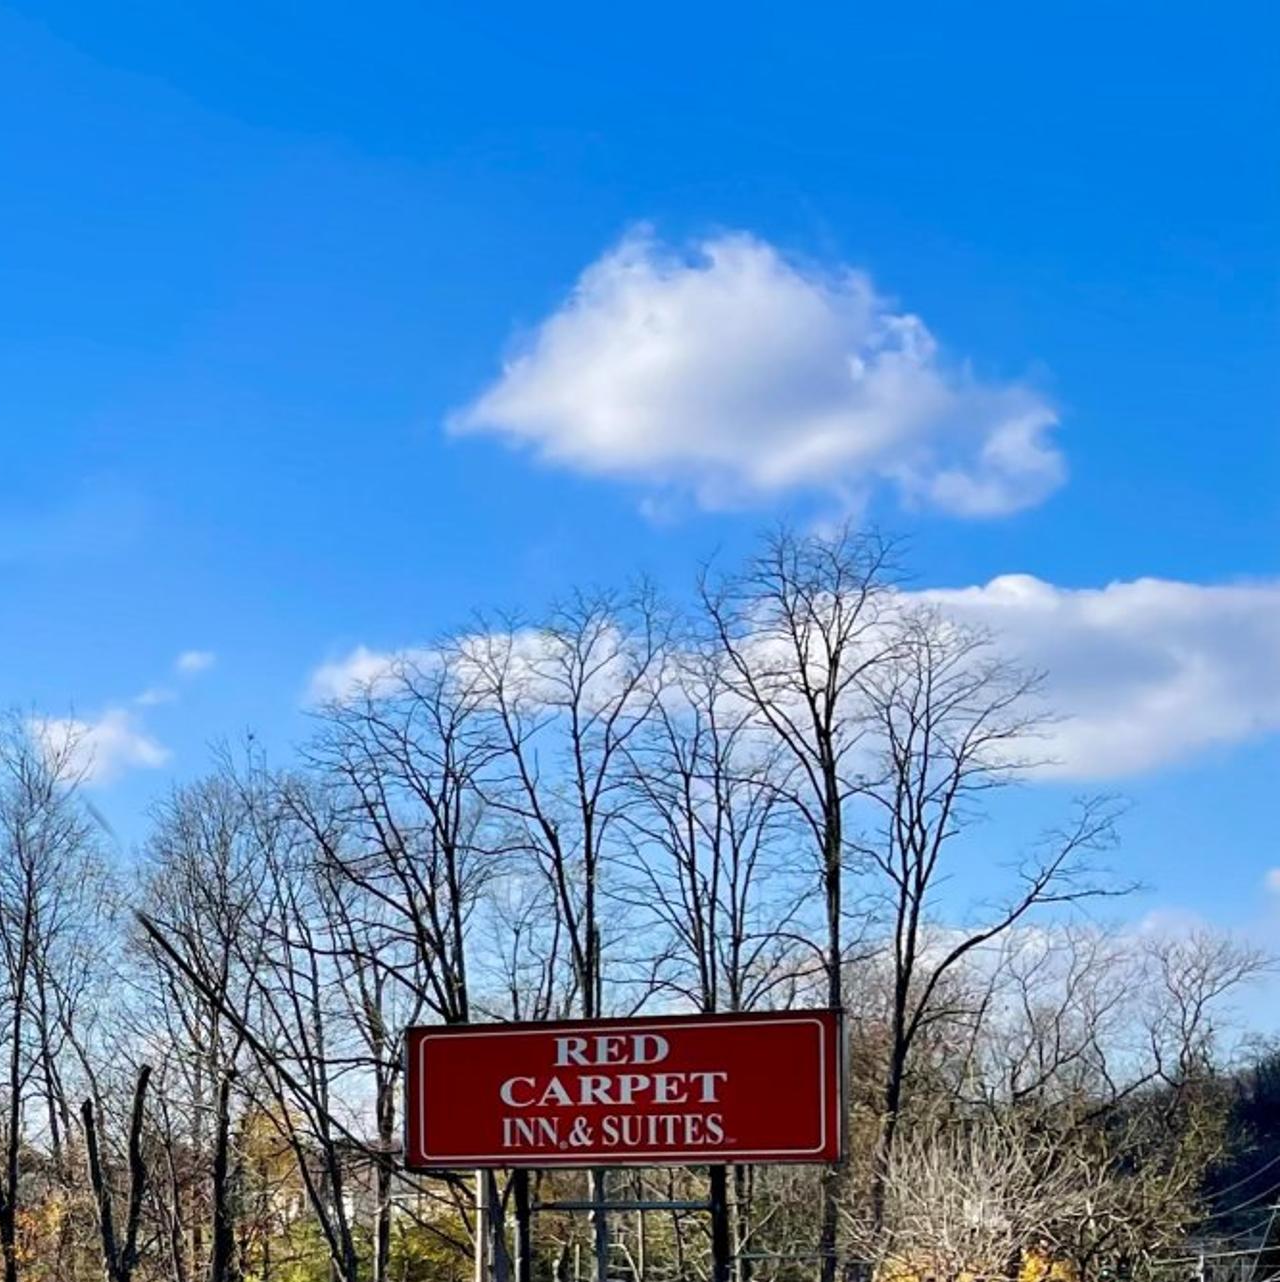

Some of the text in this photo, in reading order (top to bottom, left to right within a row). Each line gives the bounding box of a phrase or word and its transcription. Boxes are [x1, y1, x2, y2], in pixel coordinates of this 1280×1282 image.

[552, 1033, 670, 1067] RED
[499, 1071, 728, 1107] CARPET
[502, 1113, 724, 1148] INN & SUITES
